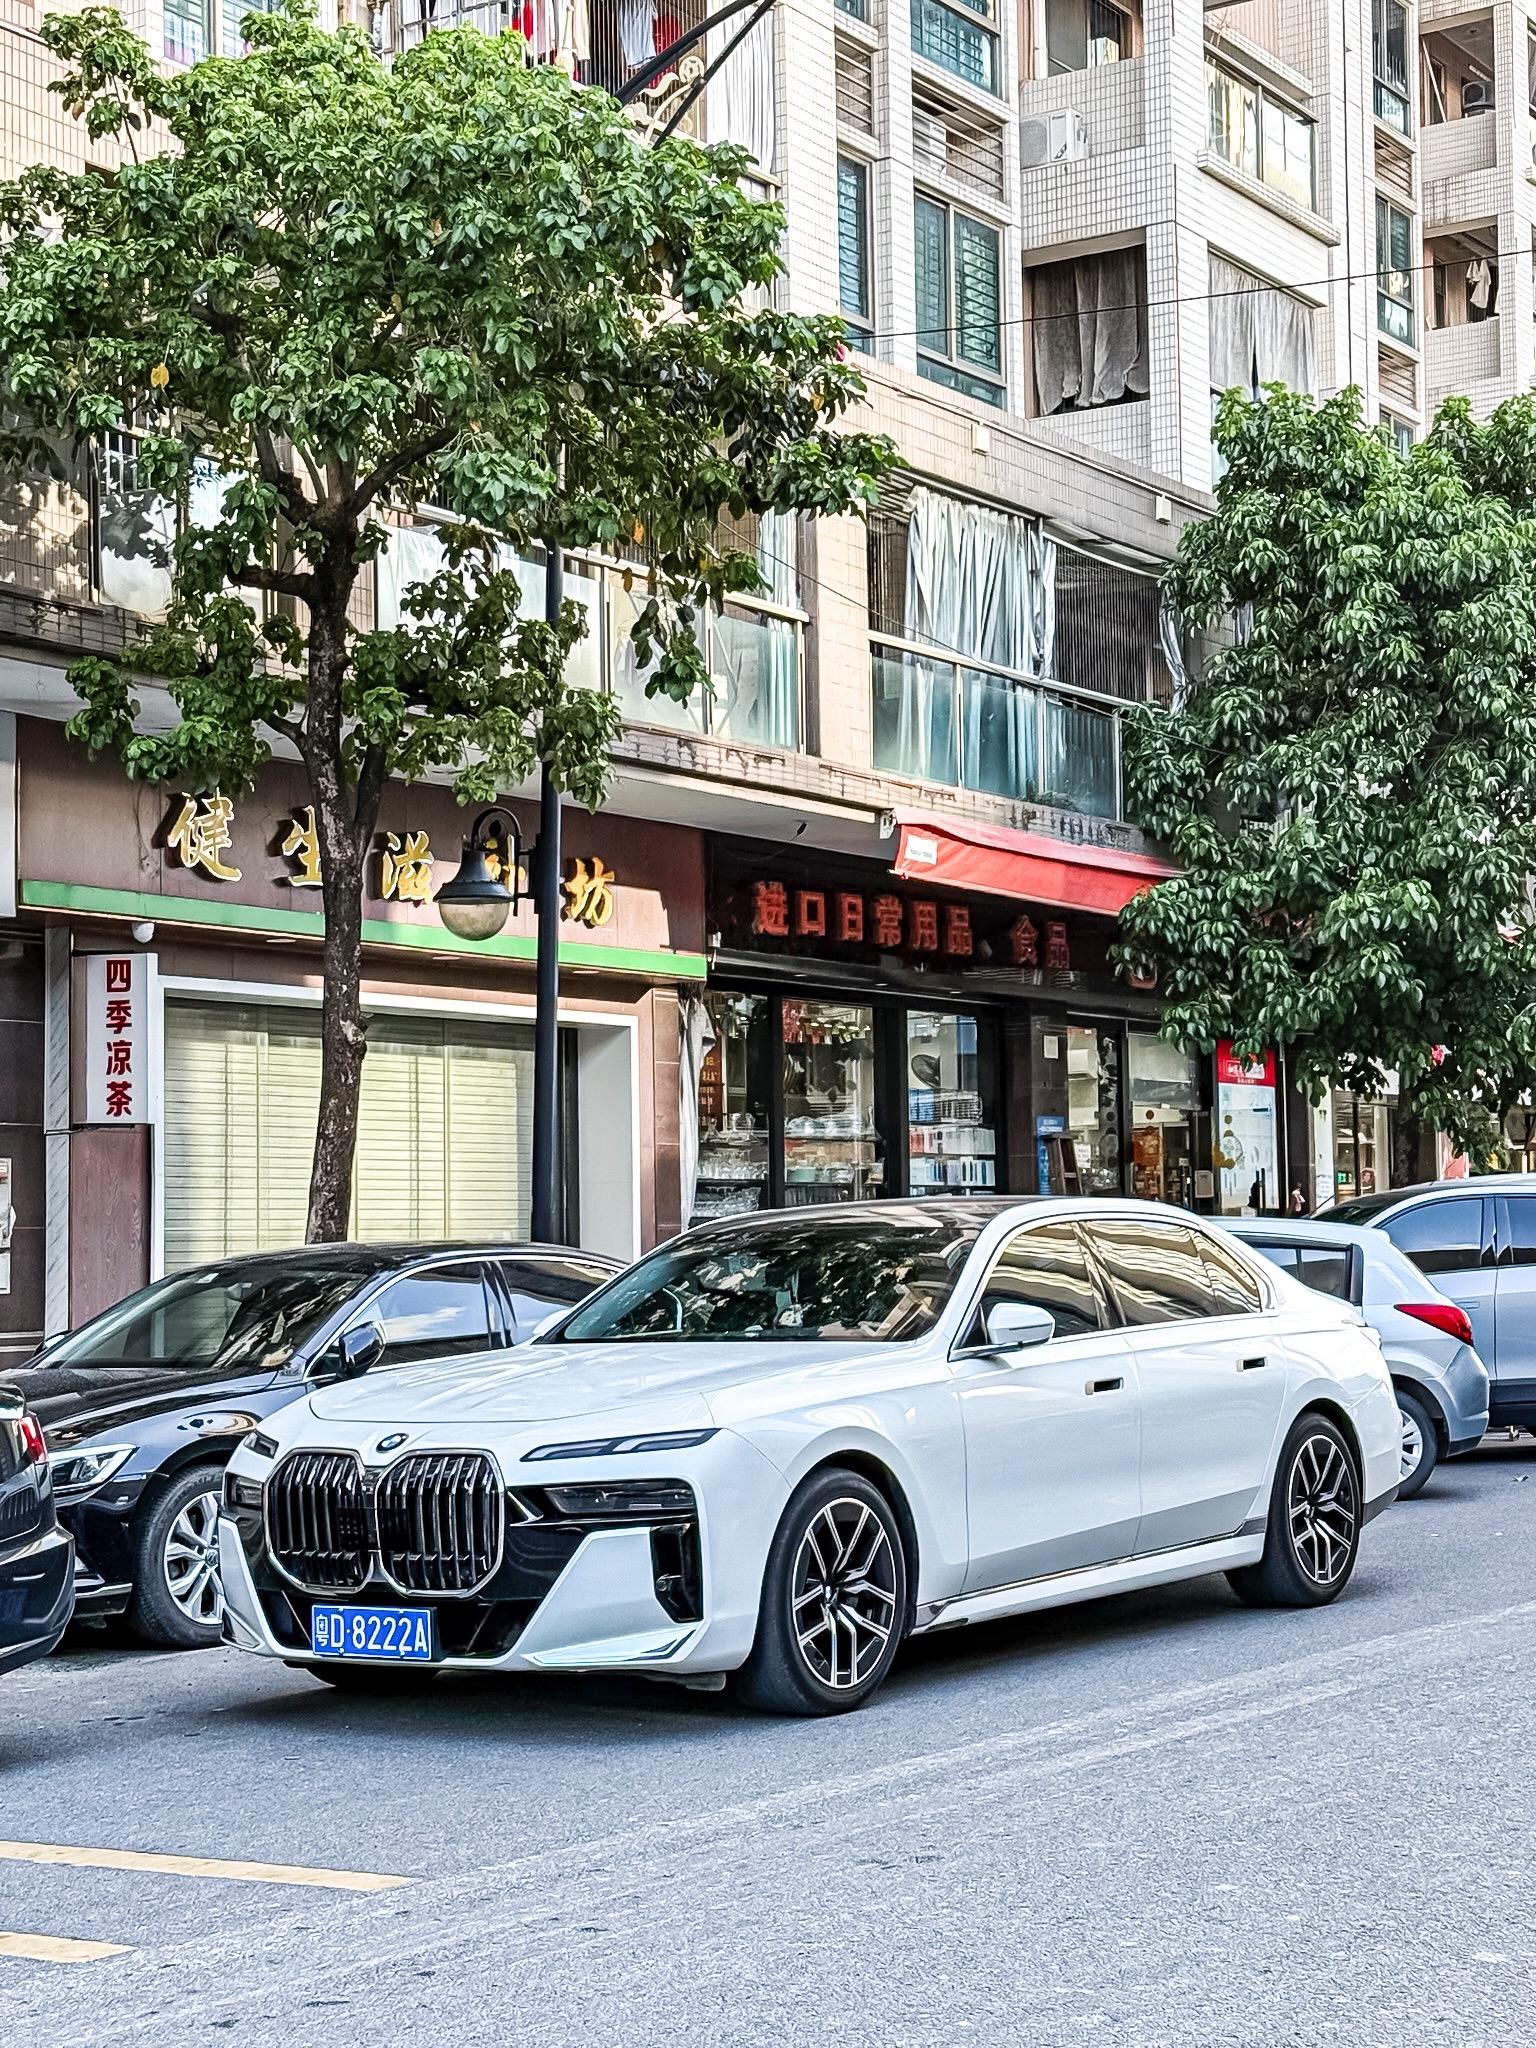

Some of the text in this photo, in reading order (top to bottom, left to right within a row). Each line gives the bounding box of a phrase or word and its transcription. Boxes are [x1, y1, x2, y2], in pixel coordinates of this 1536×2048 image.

[105, 958, 133, 1118] 四季凉茶
[315, 1613, 428, 1653] 粤D·8222A
